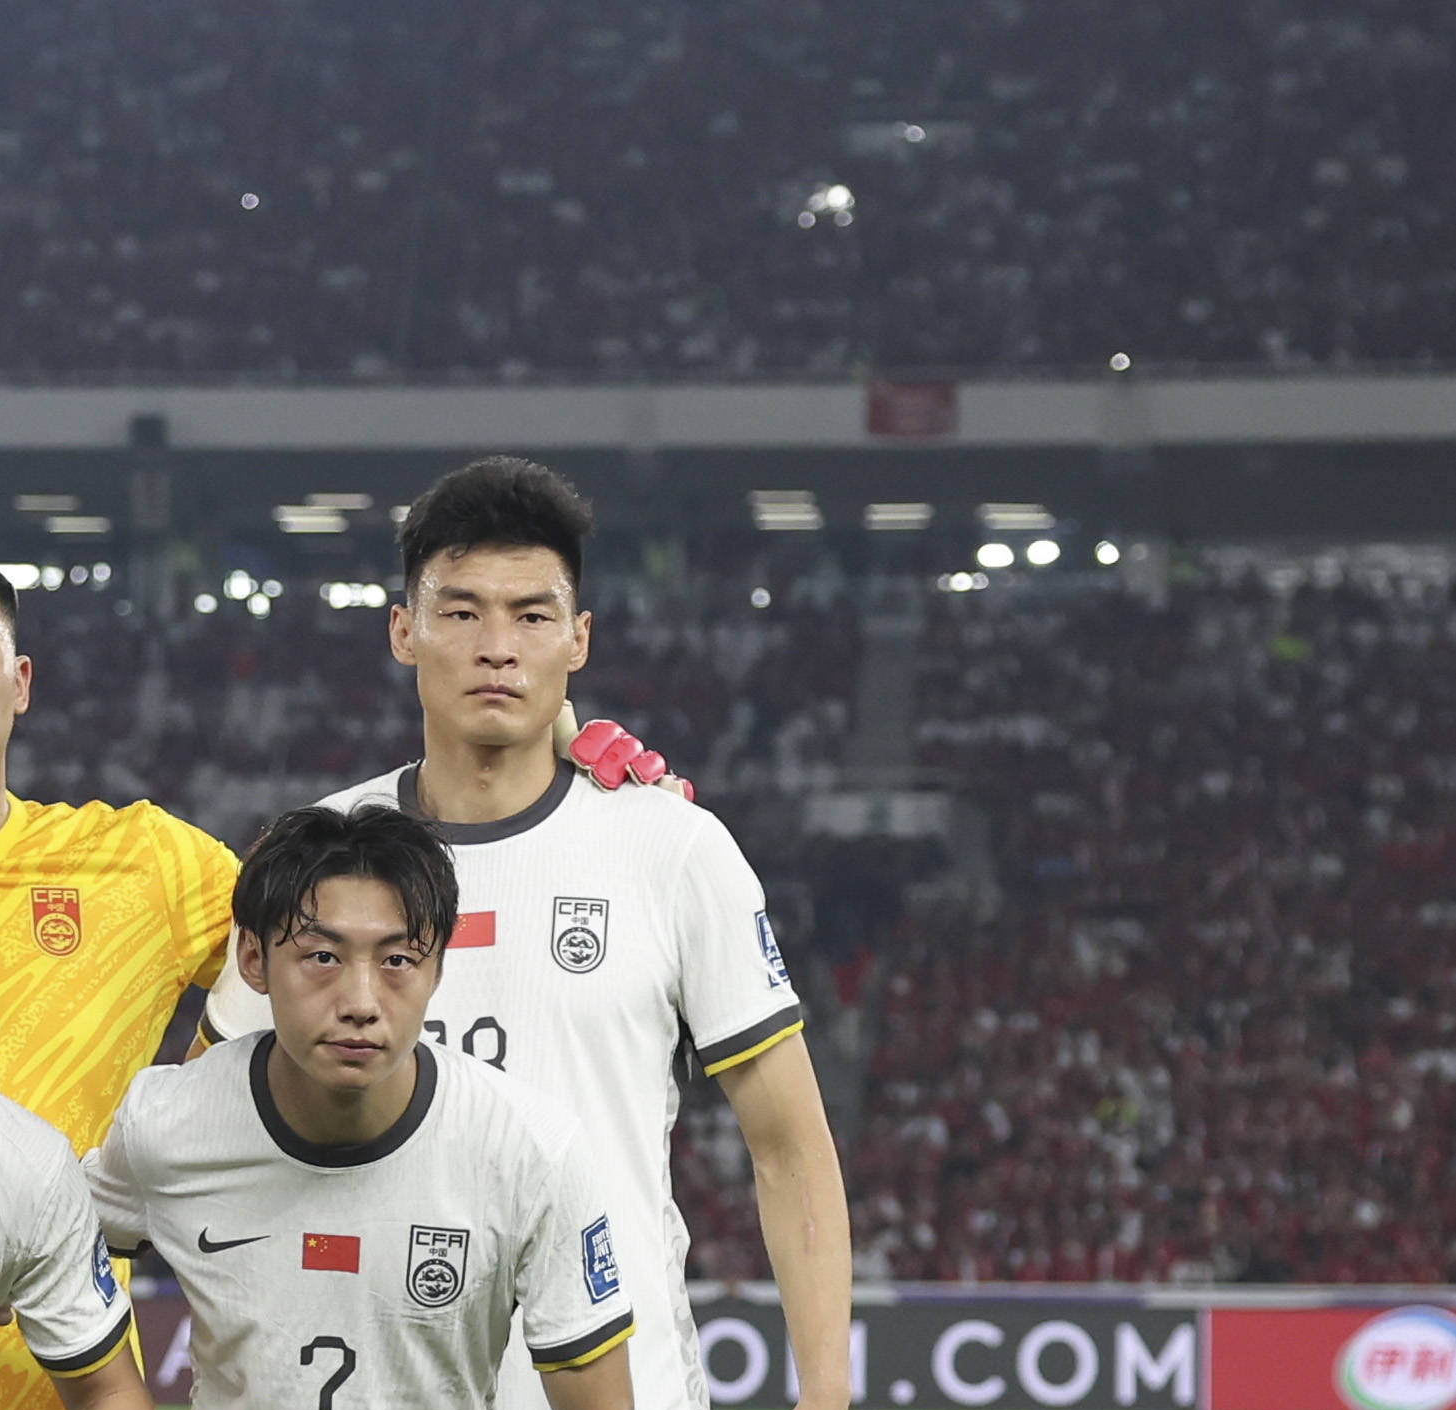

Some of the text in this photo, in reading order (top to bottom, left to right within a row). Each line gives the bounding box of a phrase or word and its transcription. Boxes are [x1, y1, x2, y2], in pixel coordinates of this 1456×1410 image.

[558, 901, 604, 917] CFA
[415, 1231, 463, 1248] CFA
[429, 1247, 448, 1258] 中国
